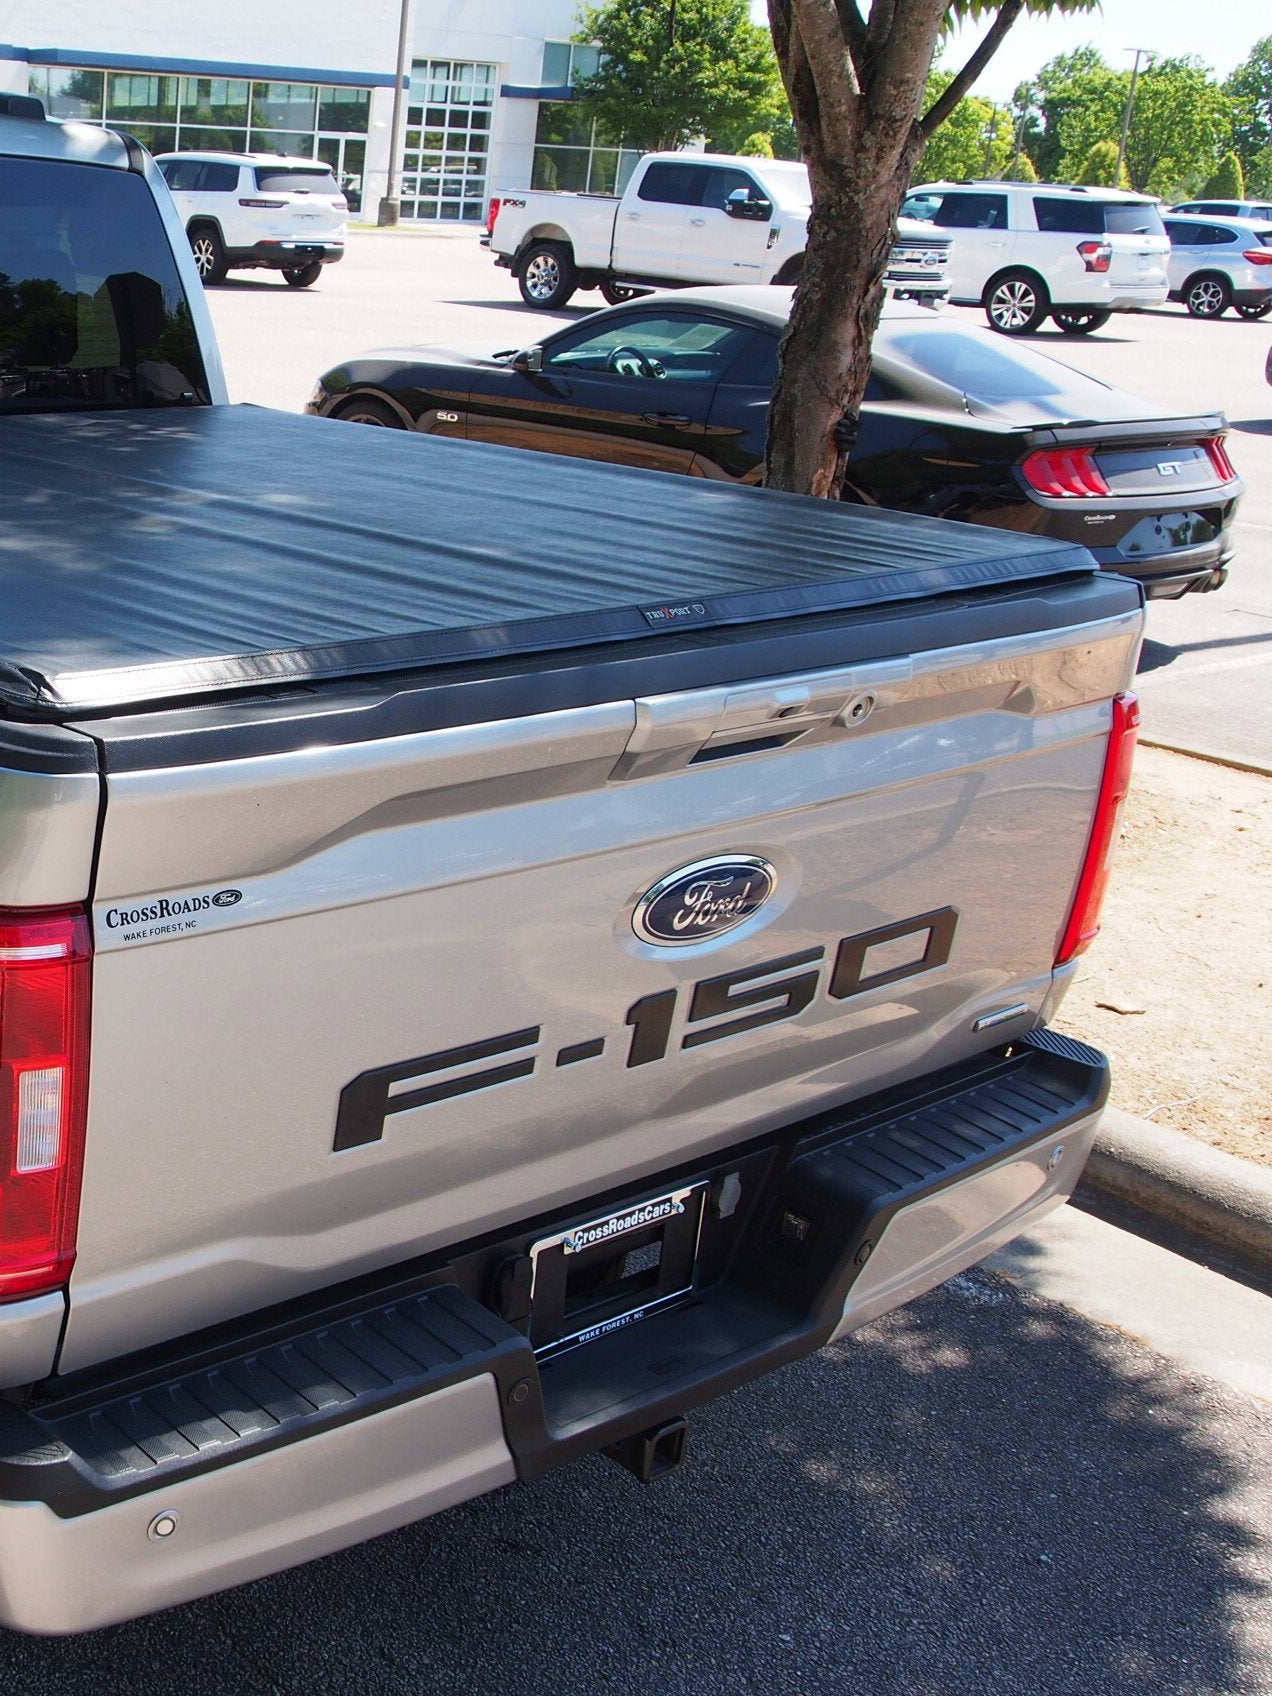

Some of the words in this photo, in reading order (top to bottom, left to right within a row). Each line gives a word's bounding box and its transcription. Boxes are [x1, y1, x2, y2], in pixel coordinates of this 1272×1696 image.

[503, 198, 527, 208] FX4
[1157, 461, 1182, 476] GT
[646, 606, 691, 619] TRUXPORT
[673, 876, 751, 931] Ford
[123, 929, 147, 941] WAKE
[150, 923, 184, 937] FOREST,
[185, 920, 197, 928] NC
[332, 904, 959, 1152] F-150
[575, 1201, 671, 1246] CrossRoadsCars
[579, 1327, 600, 1343] WAKE
[602, 1316, 633, 1333] FOREST,
[634, 1310, 644, 1319] NC
